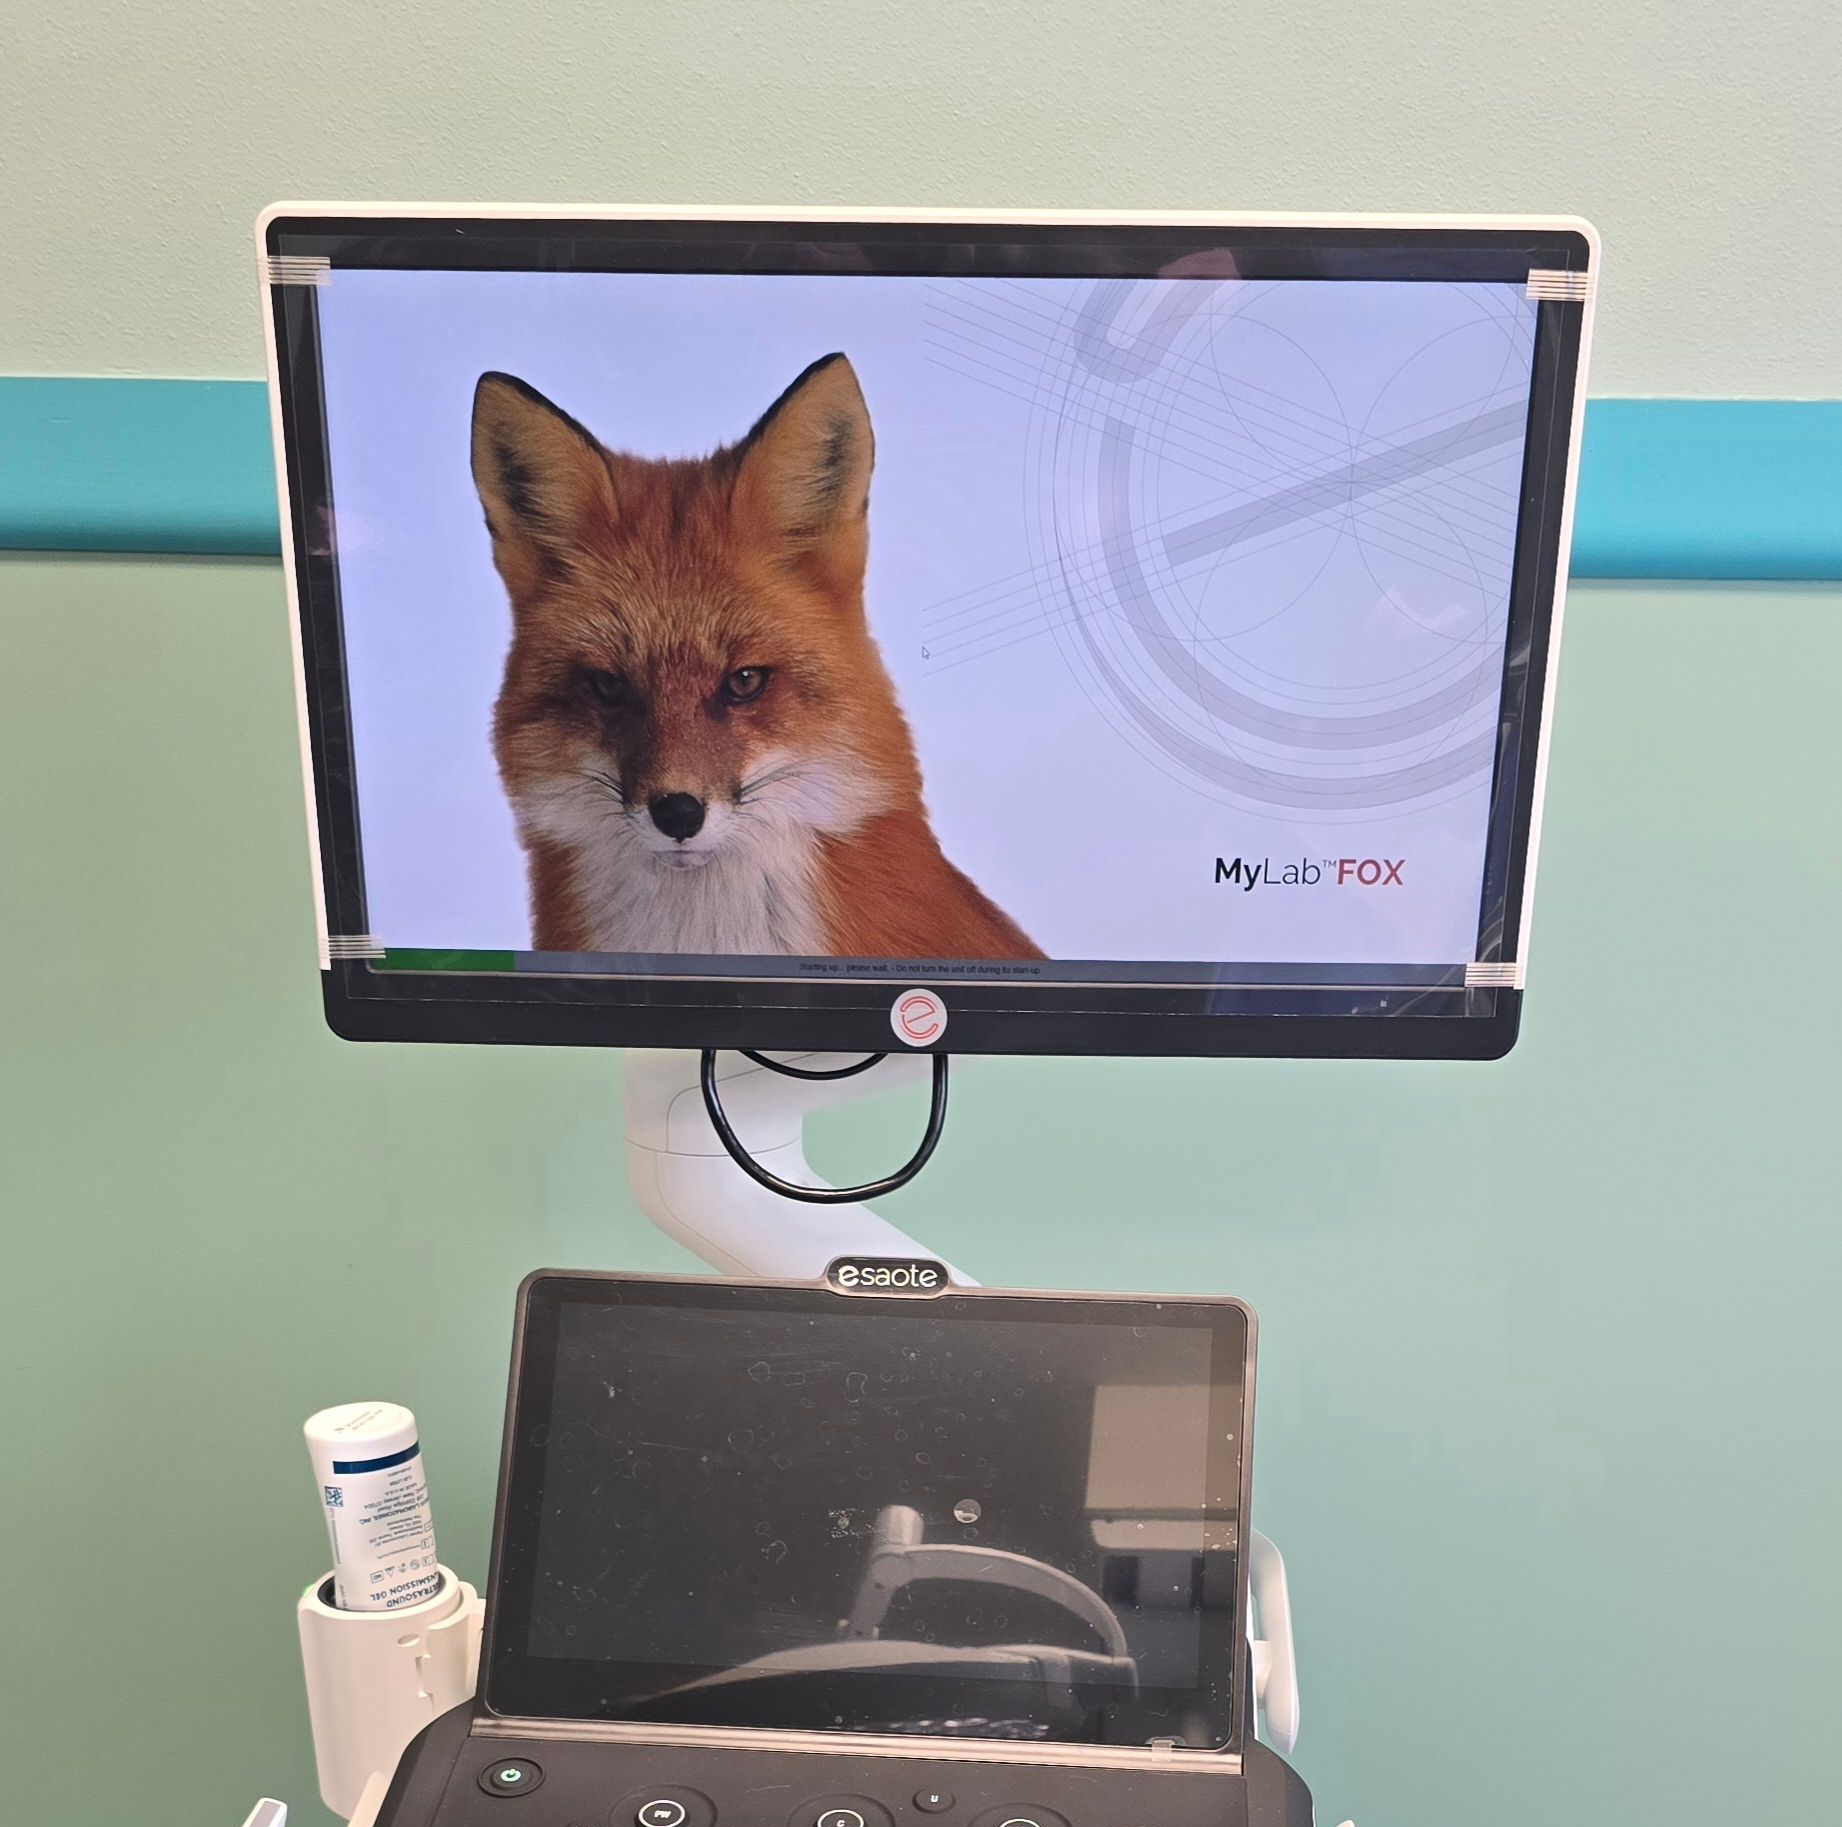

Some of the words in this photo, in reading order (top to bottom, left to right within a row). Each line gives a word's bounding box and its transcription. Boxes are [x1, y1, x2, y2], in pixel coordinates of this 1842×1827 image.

[896, 965, 906, 973] Do
[909, 965, 920, 973] not
[838, 1264, 938, 1288] esaote
[836, 1819, 845, 1827] C
